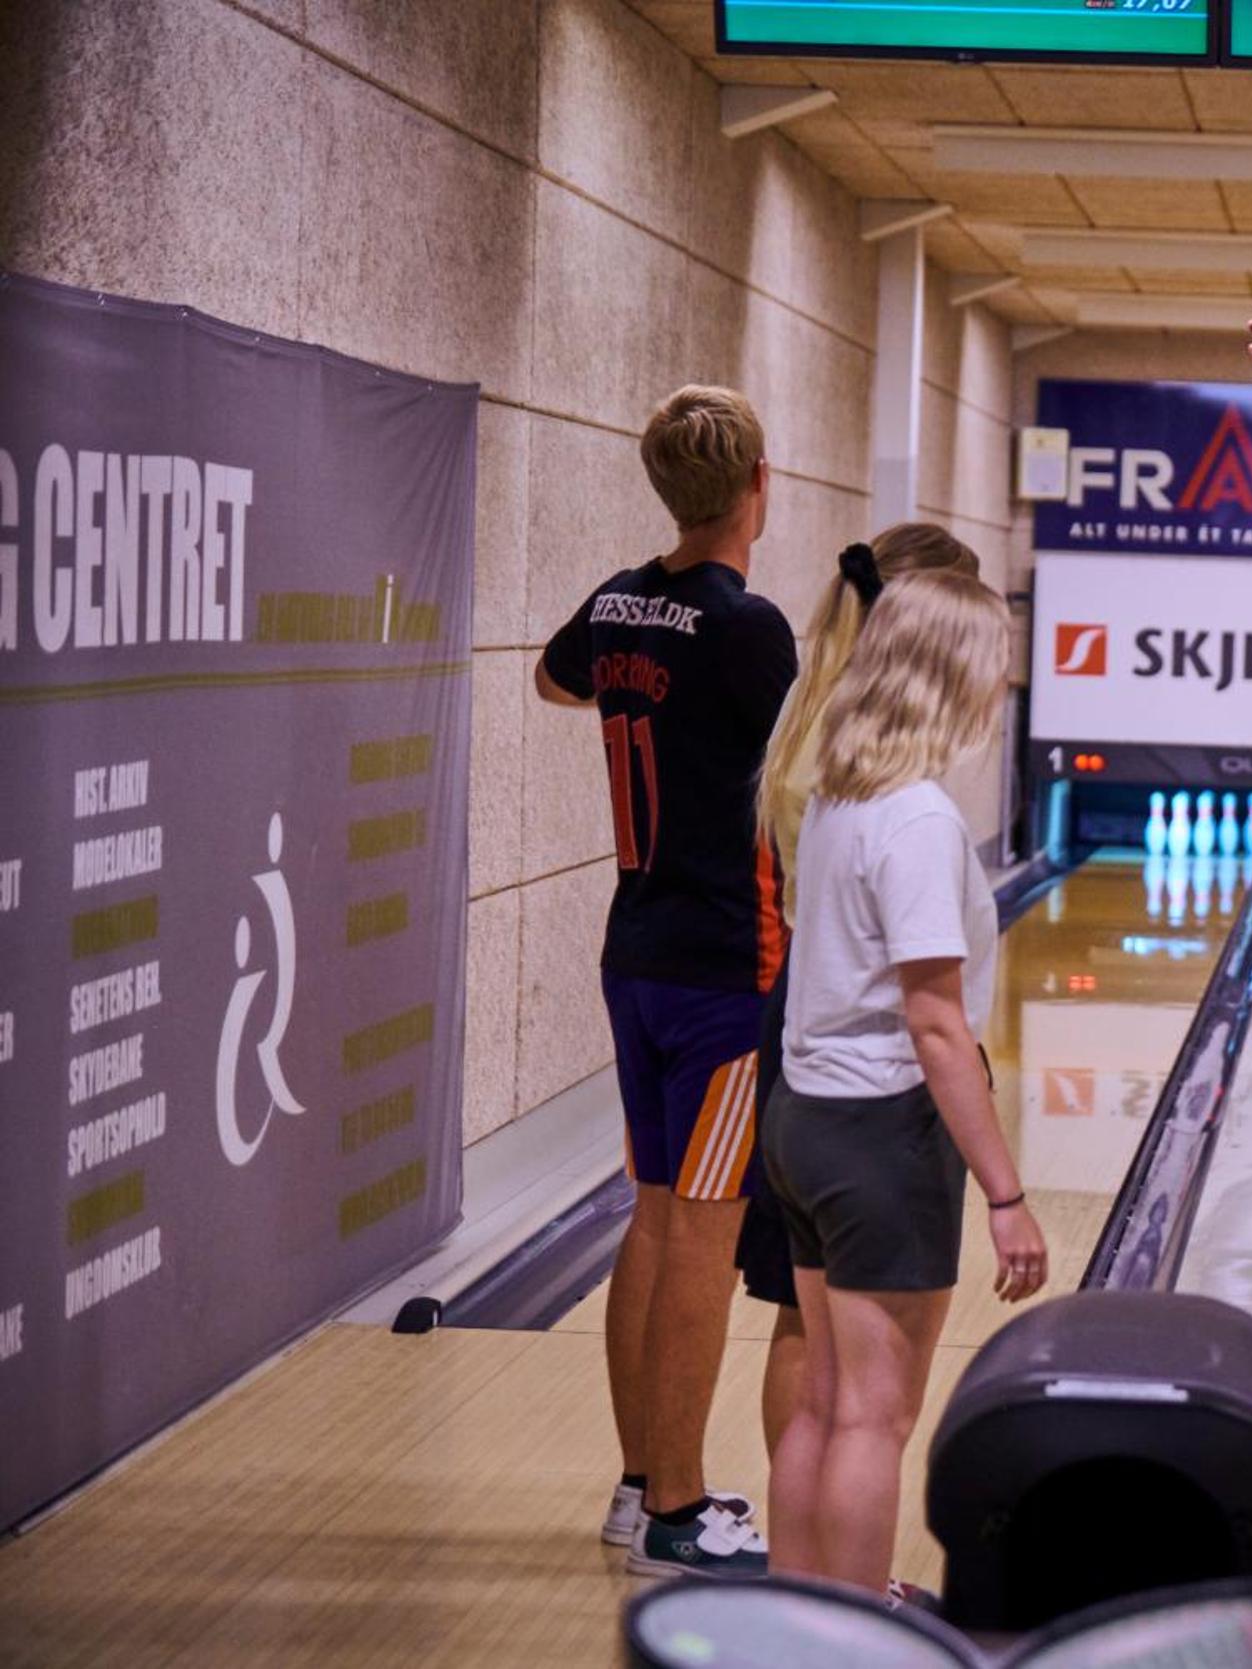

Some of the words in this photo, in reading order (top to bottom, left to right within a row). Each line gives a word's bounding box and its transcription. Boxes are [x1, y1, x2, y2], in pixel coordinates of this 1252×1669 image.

[1070, 522, 1106, 538] ALT
[1116, 524, 1189, 542] UNDER
[33, 443, 253, 653] CENTRET
[1048, 746, 1064, 774] 1
